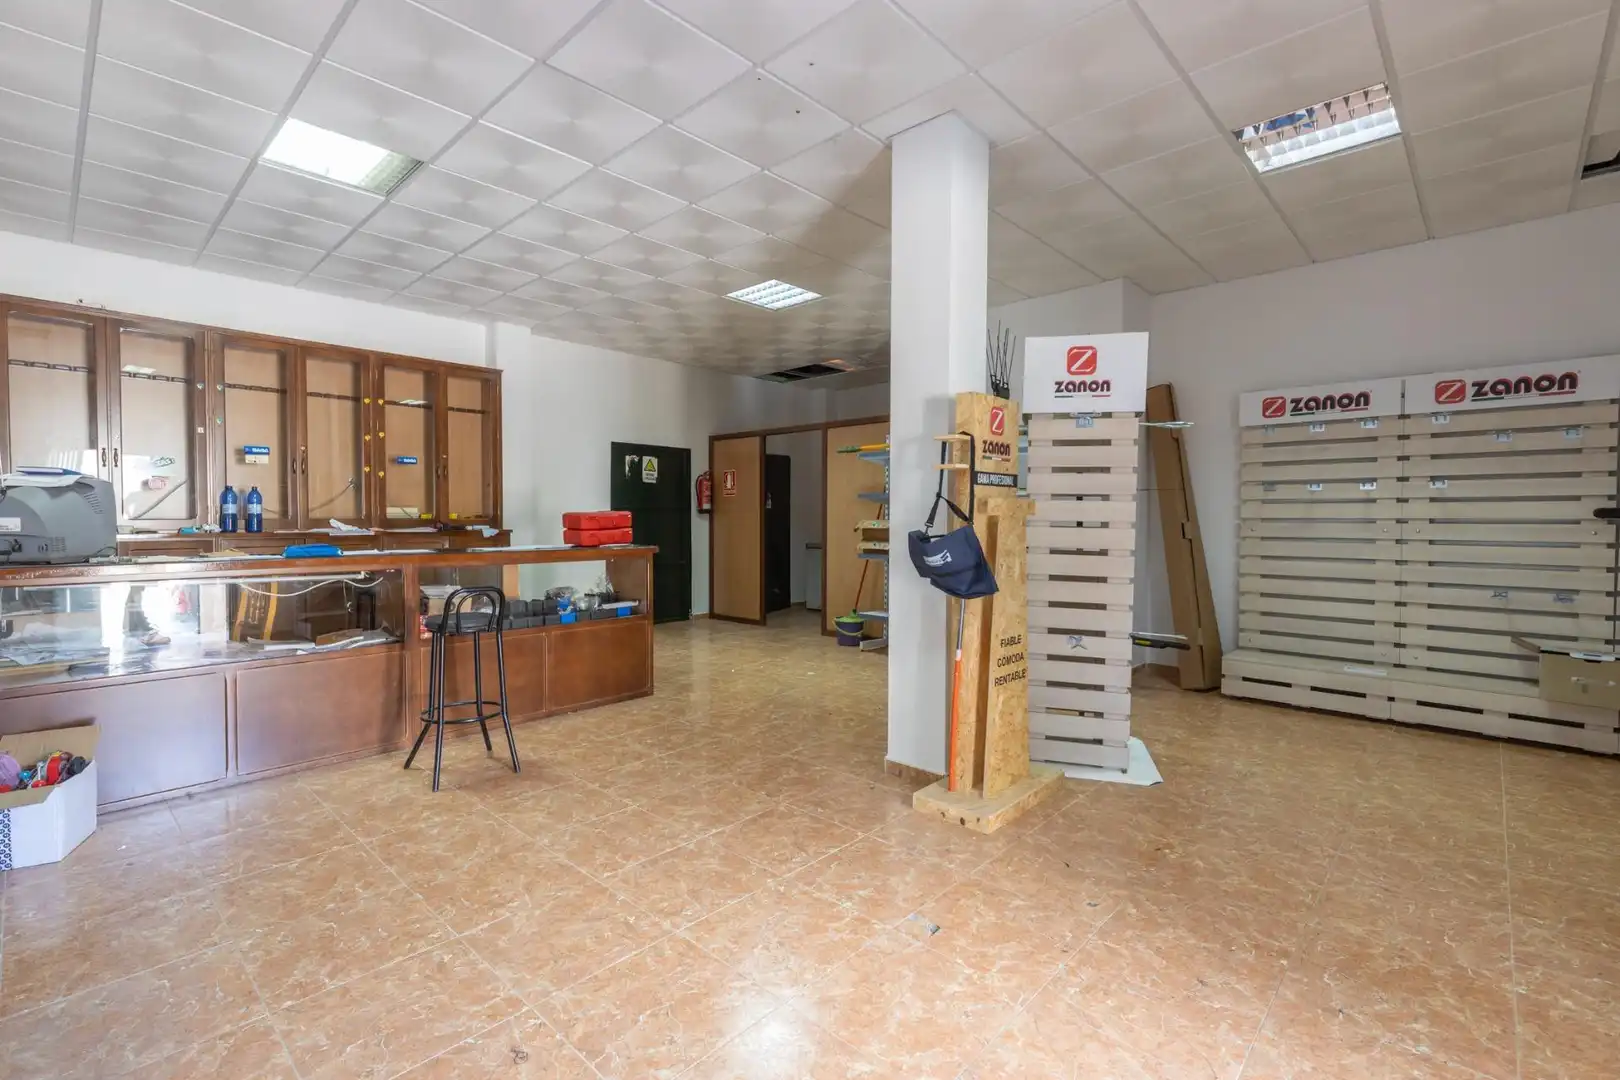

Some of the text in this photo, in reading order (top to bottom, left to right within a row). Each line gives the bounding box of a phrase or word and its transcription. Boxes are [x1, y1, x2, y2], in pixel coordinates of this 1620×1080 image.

[1054, 379, 1111, 393] zanon
[1471, 371, 1578, 398] zanon
[1290, 391, 1371, 413] zanon
[982, 439, 1011, 456] zanon
[1000, 634, 1022, 648] FIABLE
[994, 668, 1027, 687] RENTABLE
